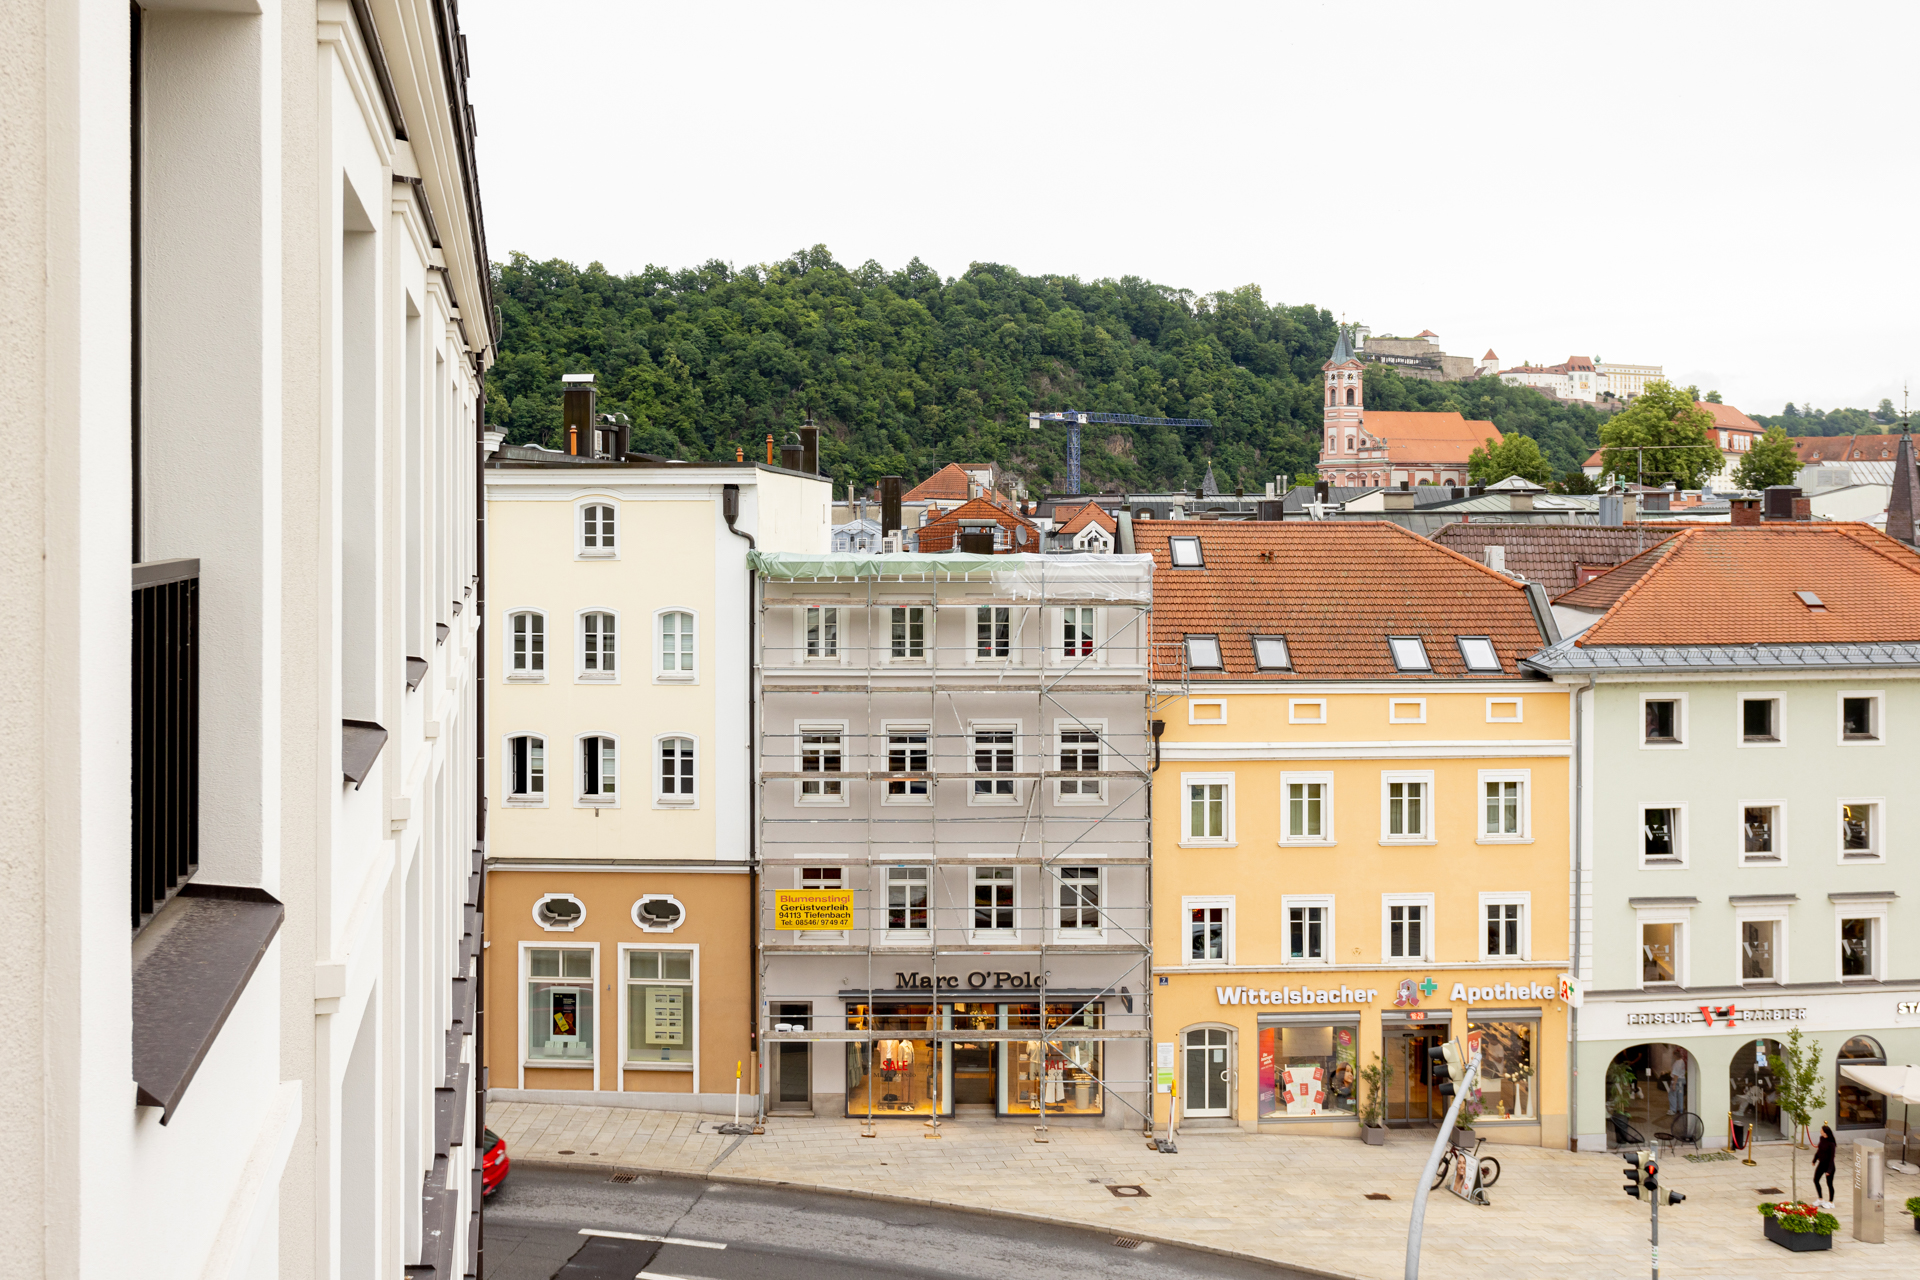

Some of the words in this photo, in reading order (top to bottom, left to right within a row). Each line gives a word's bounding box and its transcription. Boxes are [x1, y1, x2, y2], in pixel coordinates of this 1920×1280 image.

[780, 895, 850, 904] Blumenstingl
[895, 972, 959, 989] Marc
[967, 971, 1048, 989] O'Polo
[1216, 984, 1378, 1005] Wittelsbacher
[1449, 982, 1556, 1005] Apotheke
[1628, 1012, 1692, 1025] FRISEUR
[1742, 1008, 1806, 1022] BARBIER
[882, 1060, 908, 1071] SALE
[1044, 1060, 1068, 1070] SALE
